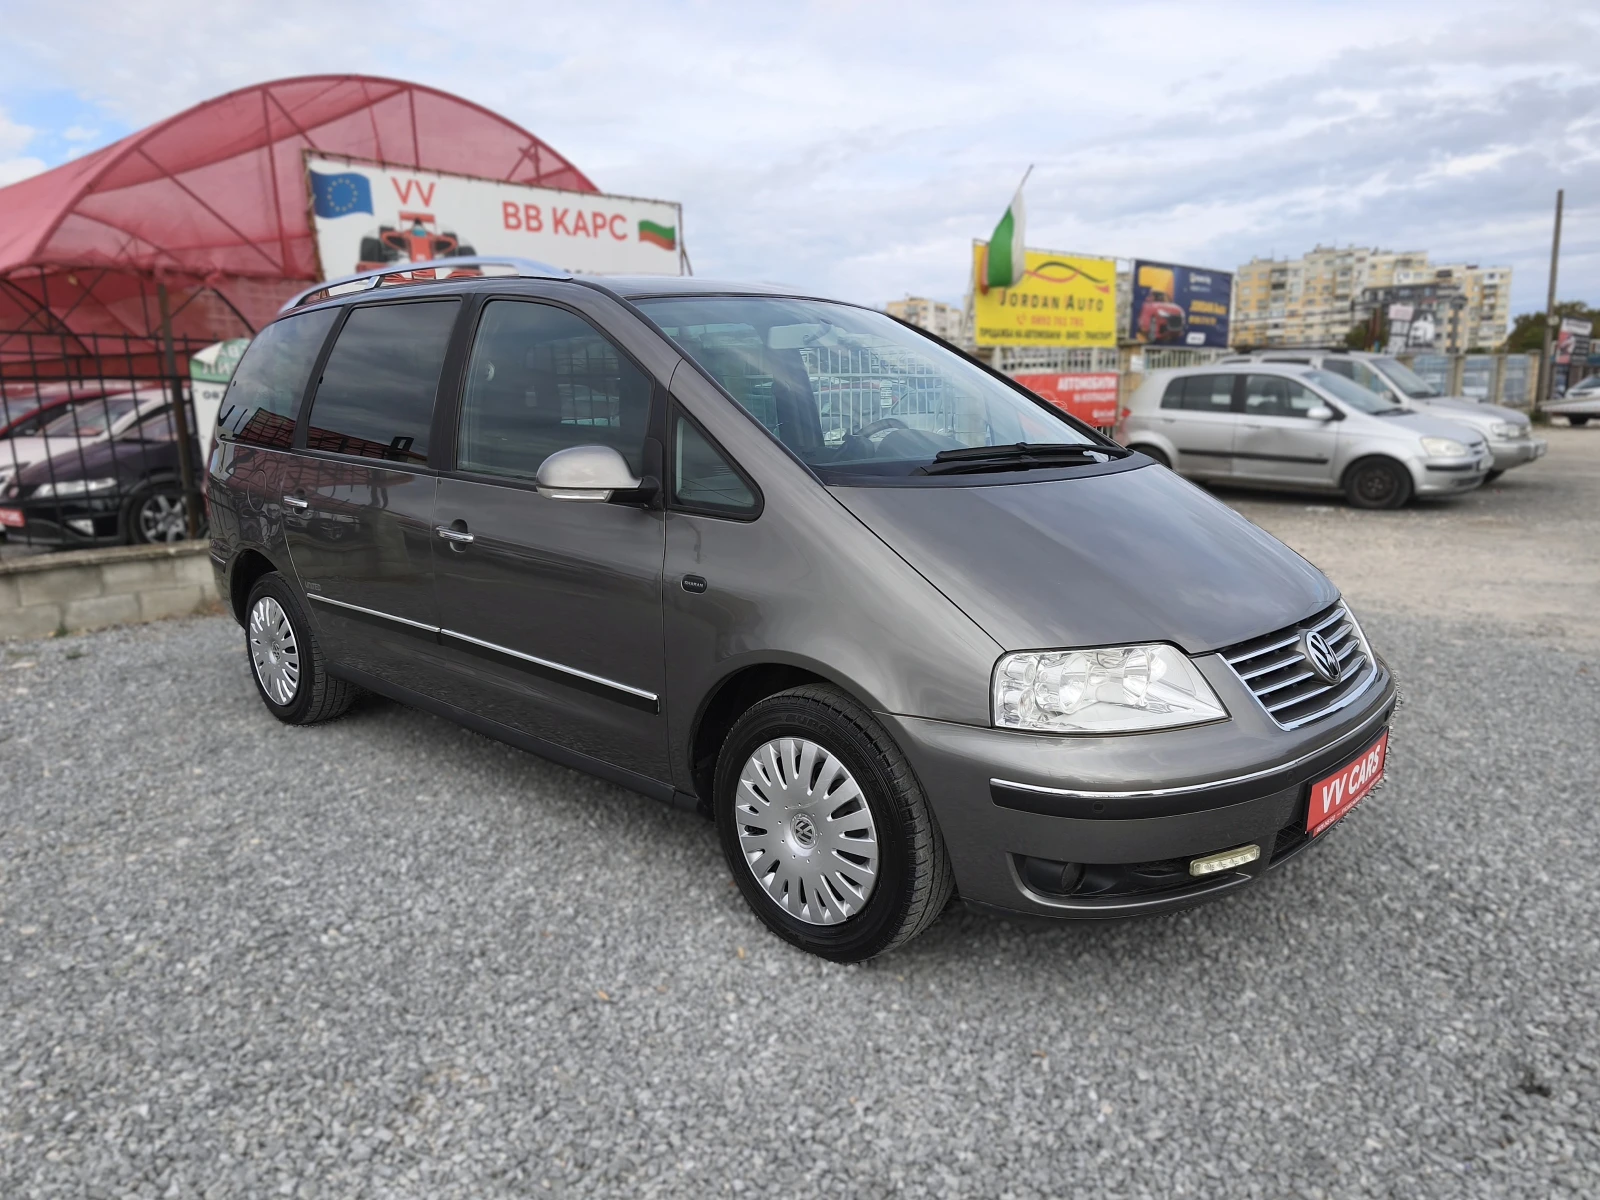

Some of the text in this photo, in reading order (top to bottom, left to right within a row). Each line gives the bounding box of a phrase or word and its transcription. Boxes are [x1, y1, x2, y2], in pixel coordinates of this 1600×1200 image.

[391, 177, 436, 207] VV
[552, 207, 629, 241] КАРС
[999, 289, 1104, 312] JORDAN AUTO
[1322, 773, 1348, 814] VV
[1348, 745, 1381, 795] CARS
